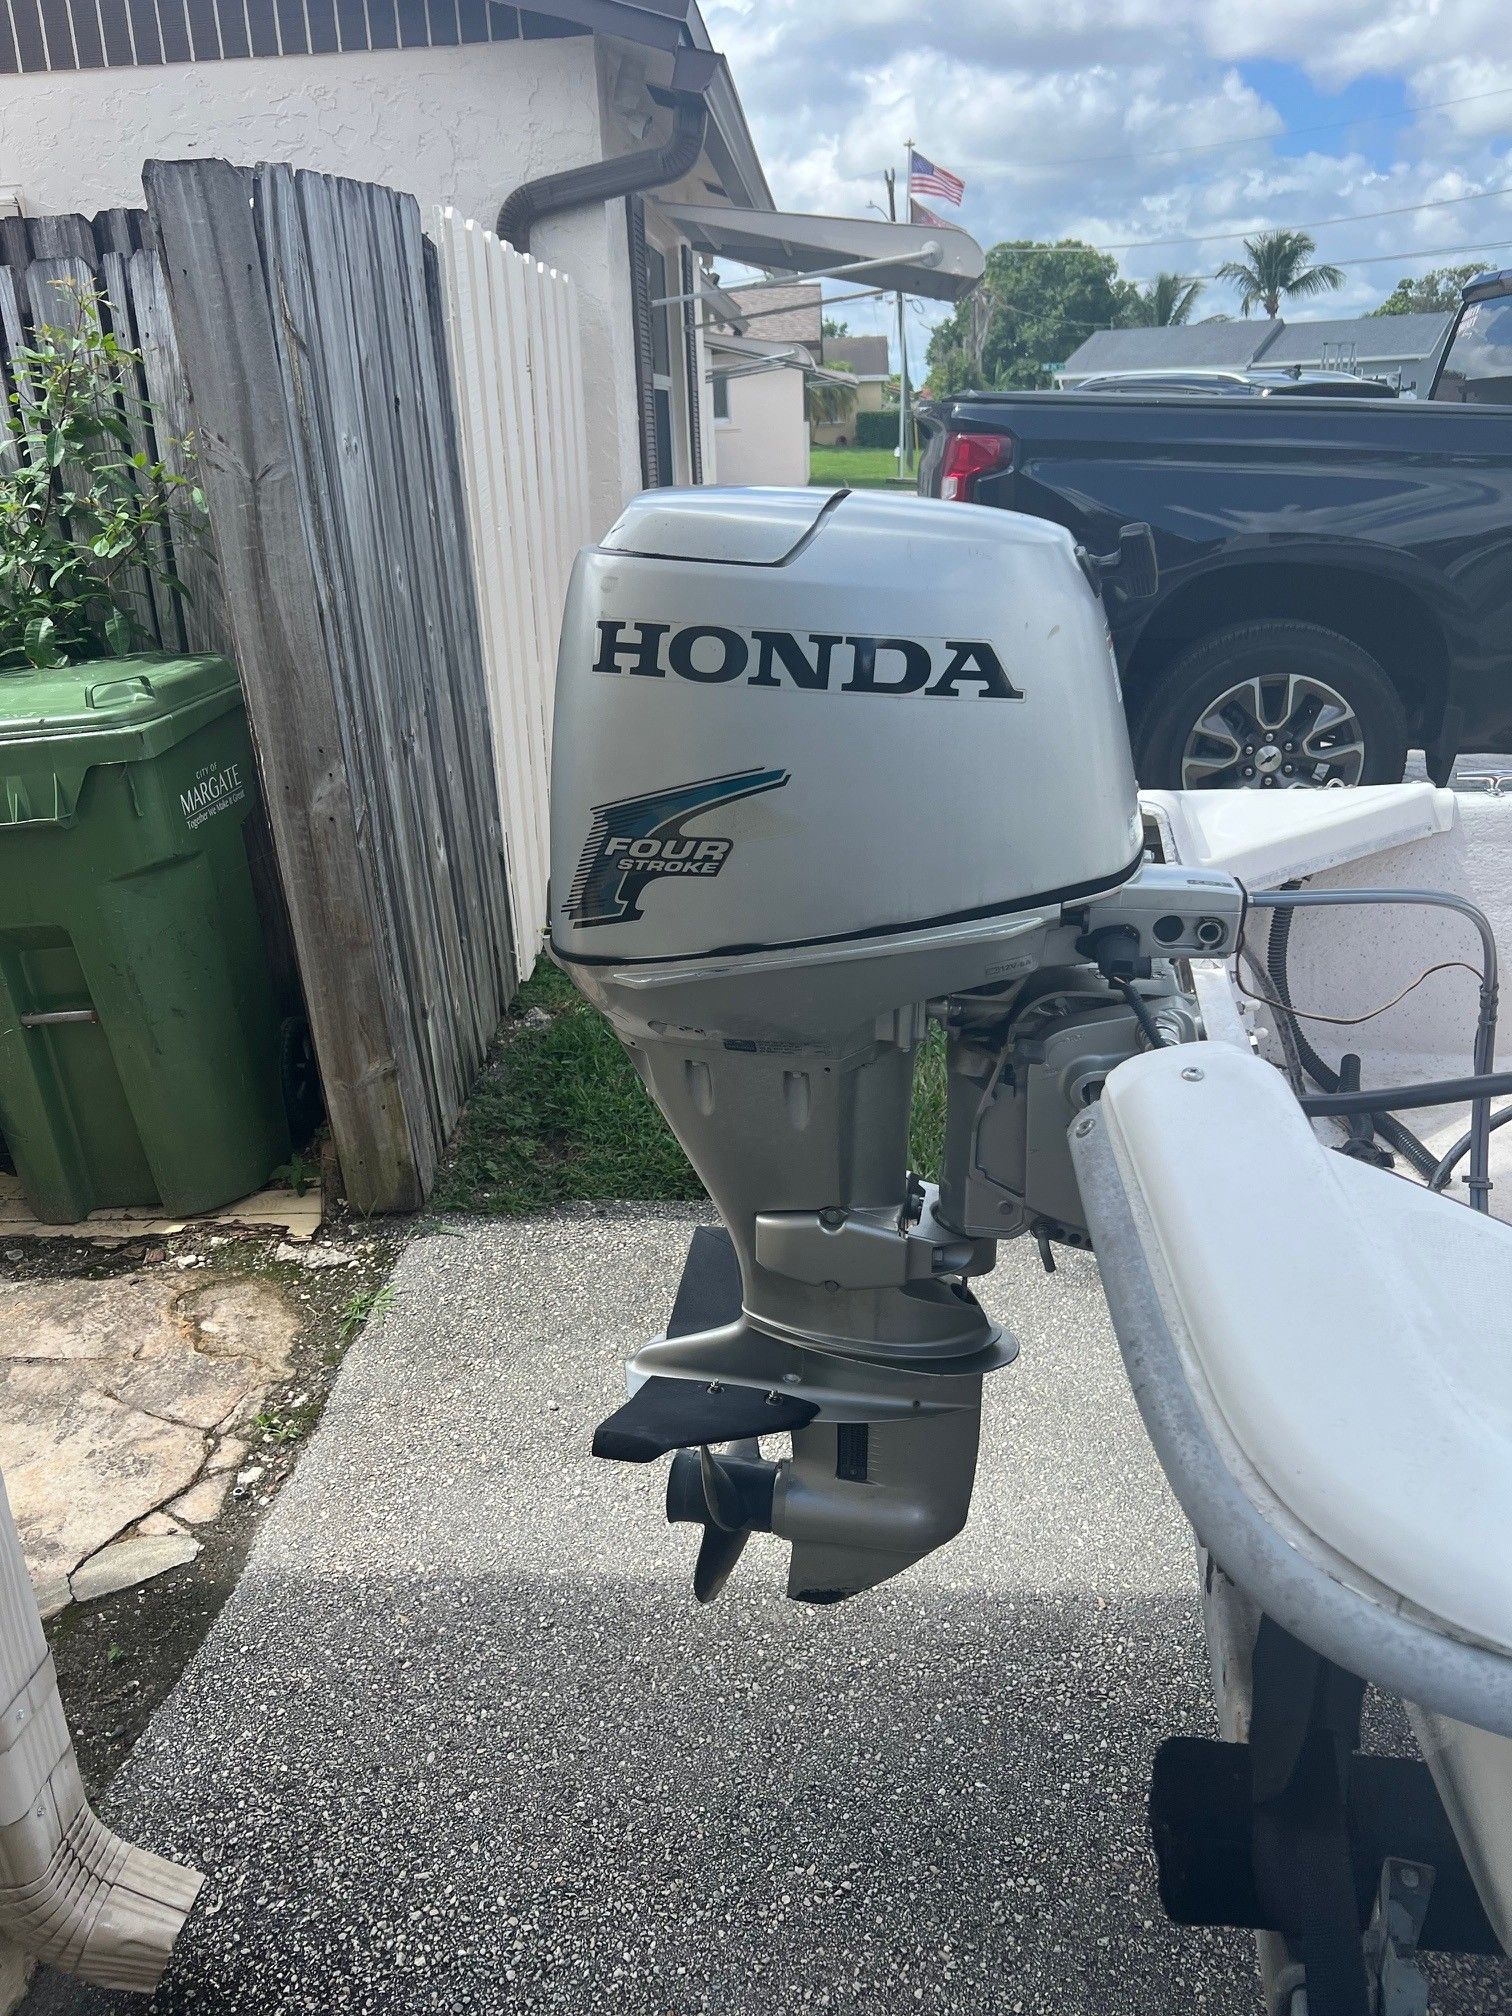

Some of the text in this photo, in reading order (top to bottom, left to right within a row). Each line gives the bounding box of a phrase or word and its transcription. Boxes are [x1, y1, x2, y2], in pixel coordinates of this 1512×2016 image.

[592, 620, 1024, 699] HONDA
[196, 762, 217, 779] CITY OF
[180, 764, 241, 816] MARGATE
[187, 812, 208, 829] Together
[207, 806, 216, 816] We
[604, 837, 731, 861] FOUR
[616, 858, 720, 874] STROKE
